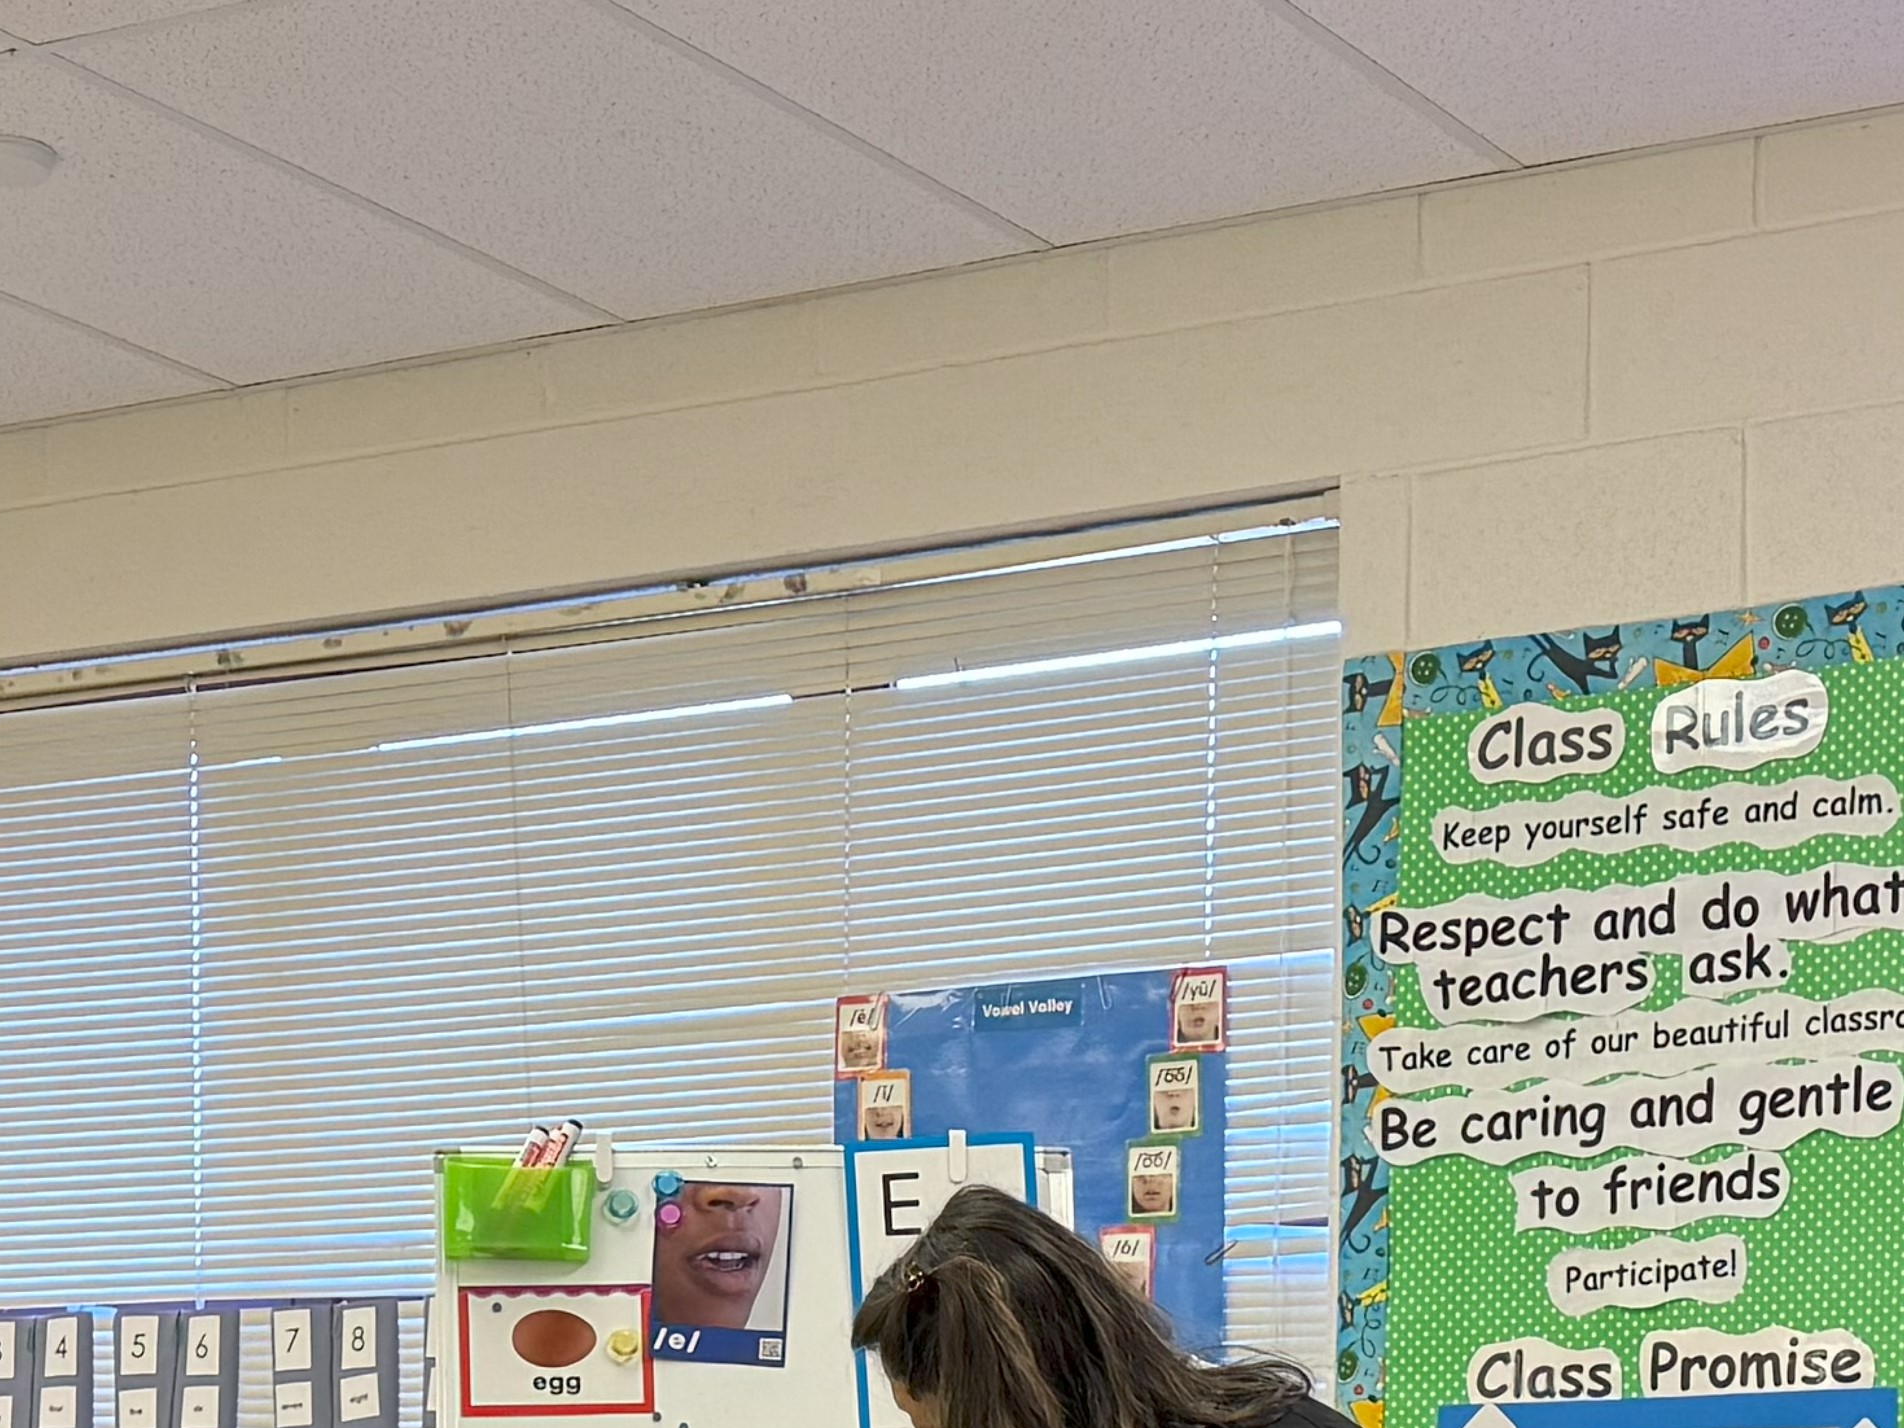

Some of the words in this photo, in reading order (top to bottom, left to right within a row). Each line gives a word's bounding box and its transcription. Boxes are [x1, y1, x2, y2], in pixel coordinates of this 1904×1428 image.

[1476, 716, 1614, 770] Class
[1664, 696, 1810, 754] Rules
[1444, 822, 1510, 852] Keep
[1525, 806, 1647, 847] yourself
[1663, 798, 1728, 830] safe
[1745, 794, 1797, 822] and
[1813, 786, 1892, 817] calm.
[1378, 902, 1570, 959] Respect
[1594, 888, 1676, 941] and
[1702, 882, 1759, 930] do
[1432, 955, 1648, 1006] teachers
[1688, 934, 1787, 984] ask.
[983, 1001, 1024, 1017] Vowel
[1028, 999, 1072, 1014] Valley
[1379, 1042, 1452, 1071] Take
[1468, 1043, 1530, 1065] care
[1546, 1028, 1576, 1059] of
[1591, 1032, 1638, 1054] our
[1654, 1009, 1788, 1048] beautiful
[1382, 1107, 1436, 1151] Be
[1460, 1094, 1606, 1147] caring
[1630, 1078, 1714, 1128] and
[1738, 1066, 1892, 1136] gentle
[884, 1173, 921, 1236] E
[1531, 1180, 1579, 1219] to
[1602, 1154, 1782, 1214] friends
[1567, 1249, 1735, 1293] Participate!
[533, 1376, 580, 1395] egg
[1475, 1351, 1614, 1399] Class
[1651, 1338, 1864, 1393] Promise
